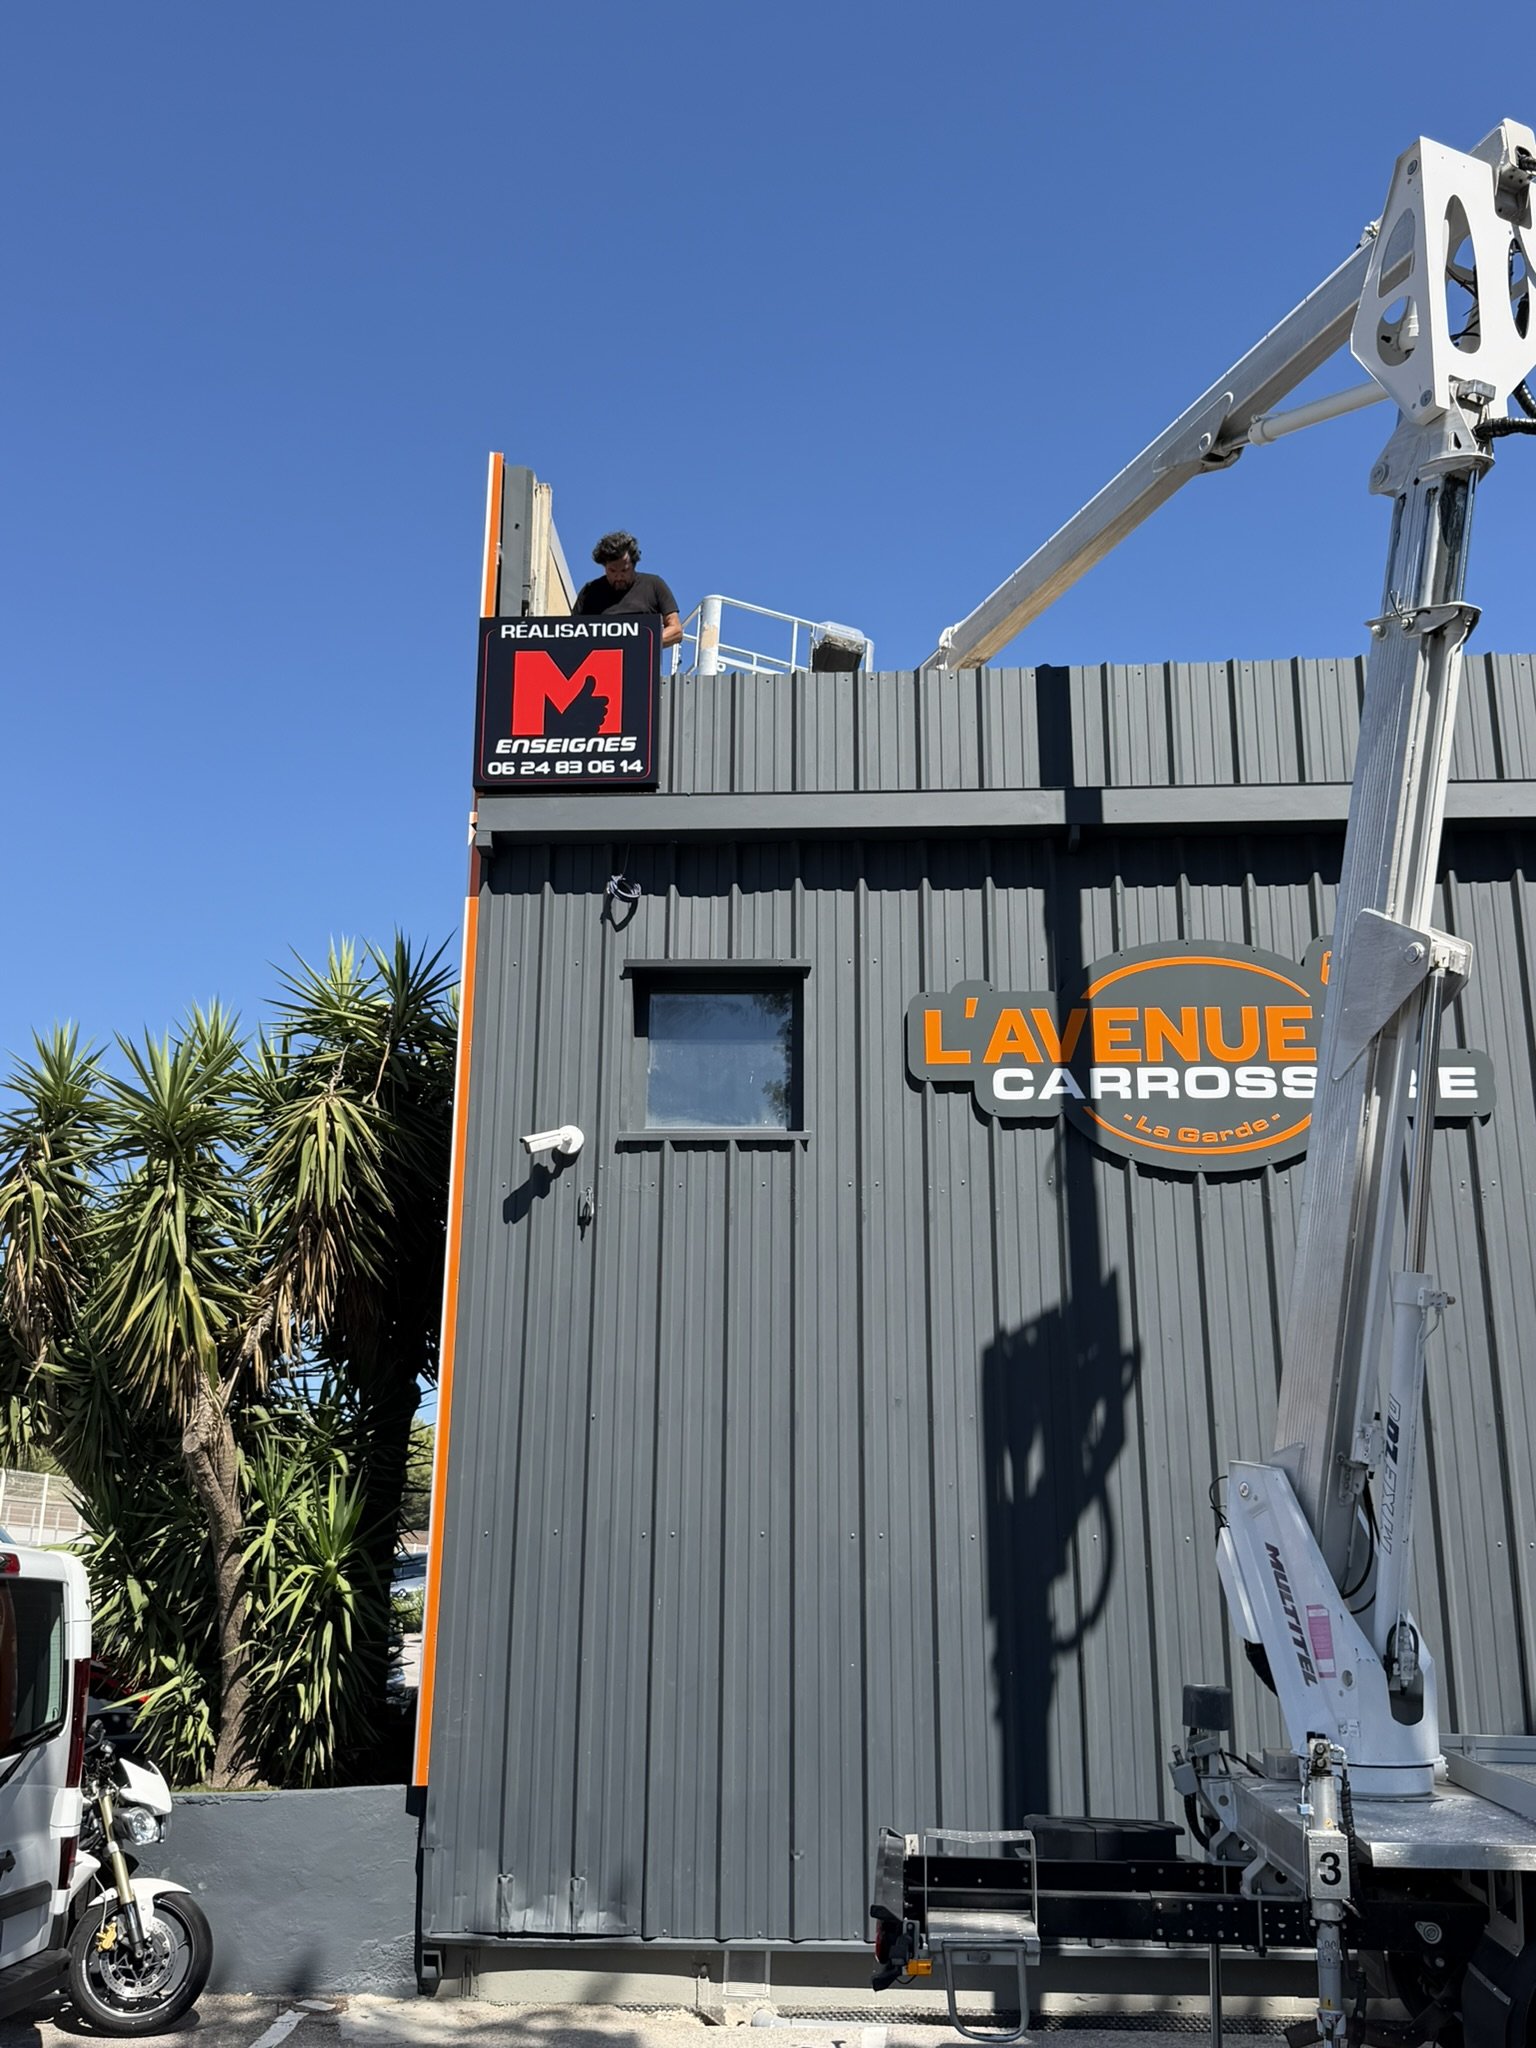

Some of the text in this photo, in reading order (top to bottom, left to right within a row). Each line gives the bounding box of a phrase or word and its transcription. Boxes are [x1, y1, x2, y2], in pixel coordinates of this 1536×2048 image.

[501, 621, 638, 638] RÉALISATION
[495, 736, 636, 754] ENSEIGNES
[488, 760, 643, 775] 06 24 83 06 14
[924, 997, 1317, 1064] L'AVENUE
[992, 1067, 1479, 1100] CARROSSE
[1265, 1541, 1318, 1688] MULTITEL
[1320, 1852, 1341, 1885] 3
